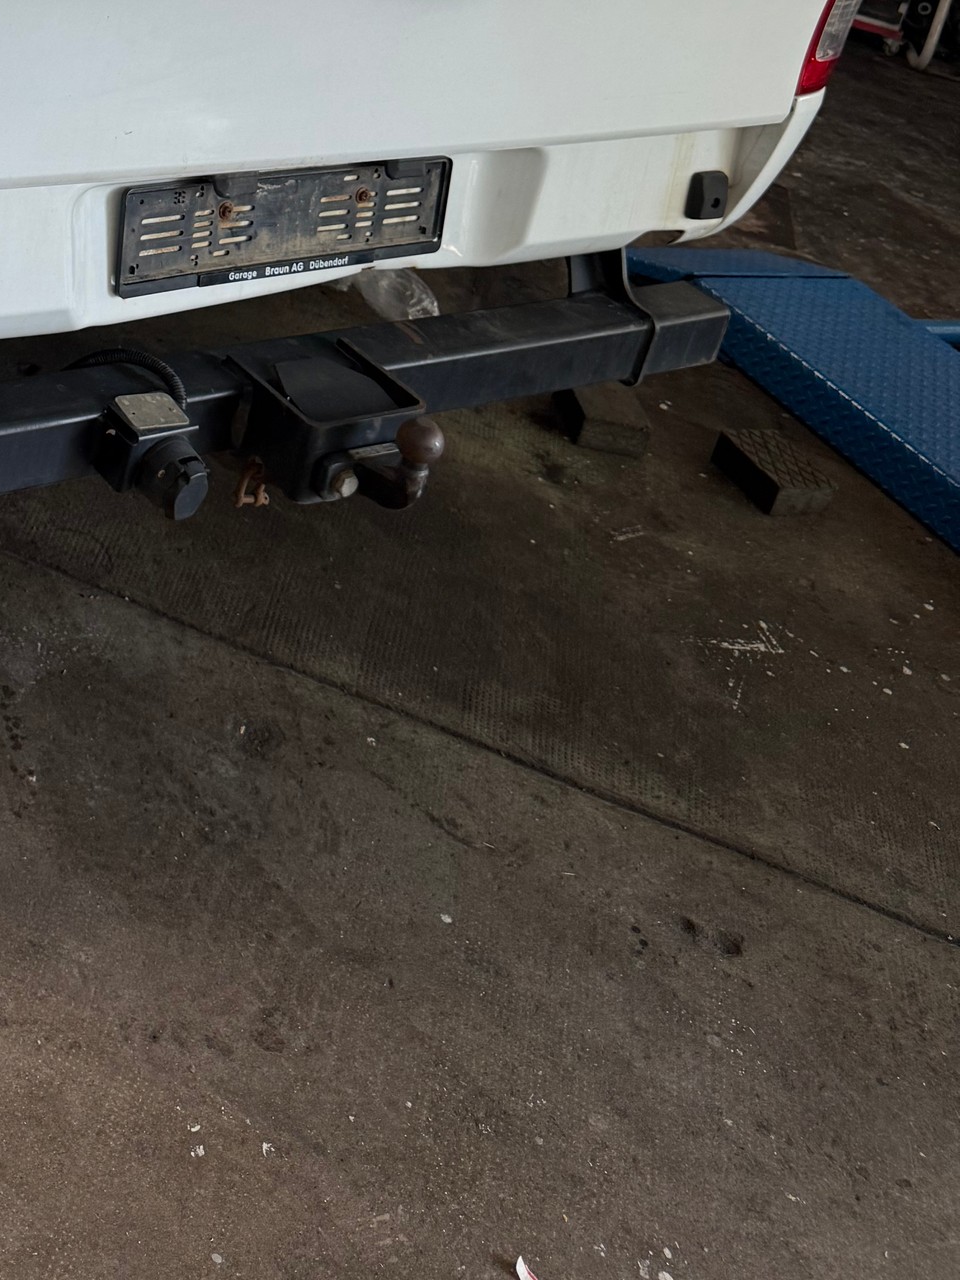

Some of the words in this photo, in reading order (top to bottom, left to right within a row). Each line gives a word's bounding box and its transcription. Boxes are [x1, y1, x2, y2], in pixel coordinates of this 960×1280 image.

[228, 270, 258, 280] Garage
[265, 265, 290, 276] Braun
[291, 262, 304, 272] AG
[309, 256, 349, 270] Dübendorf
